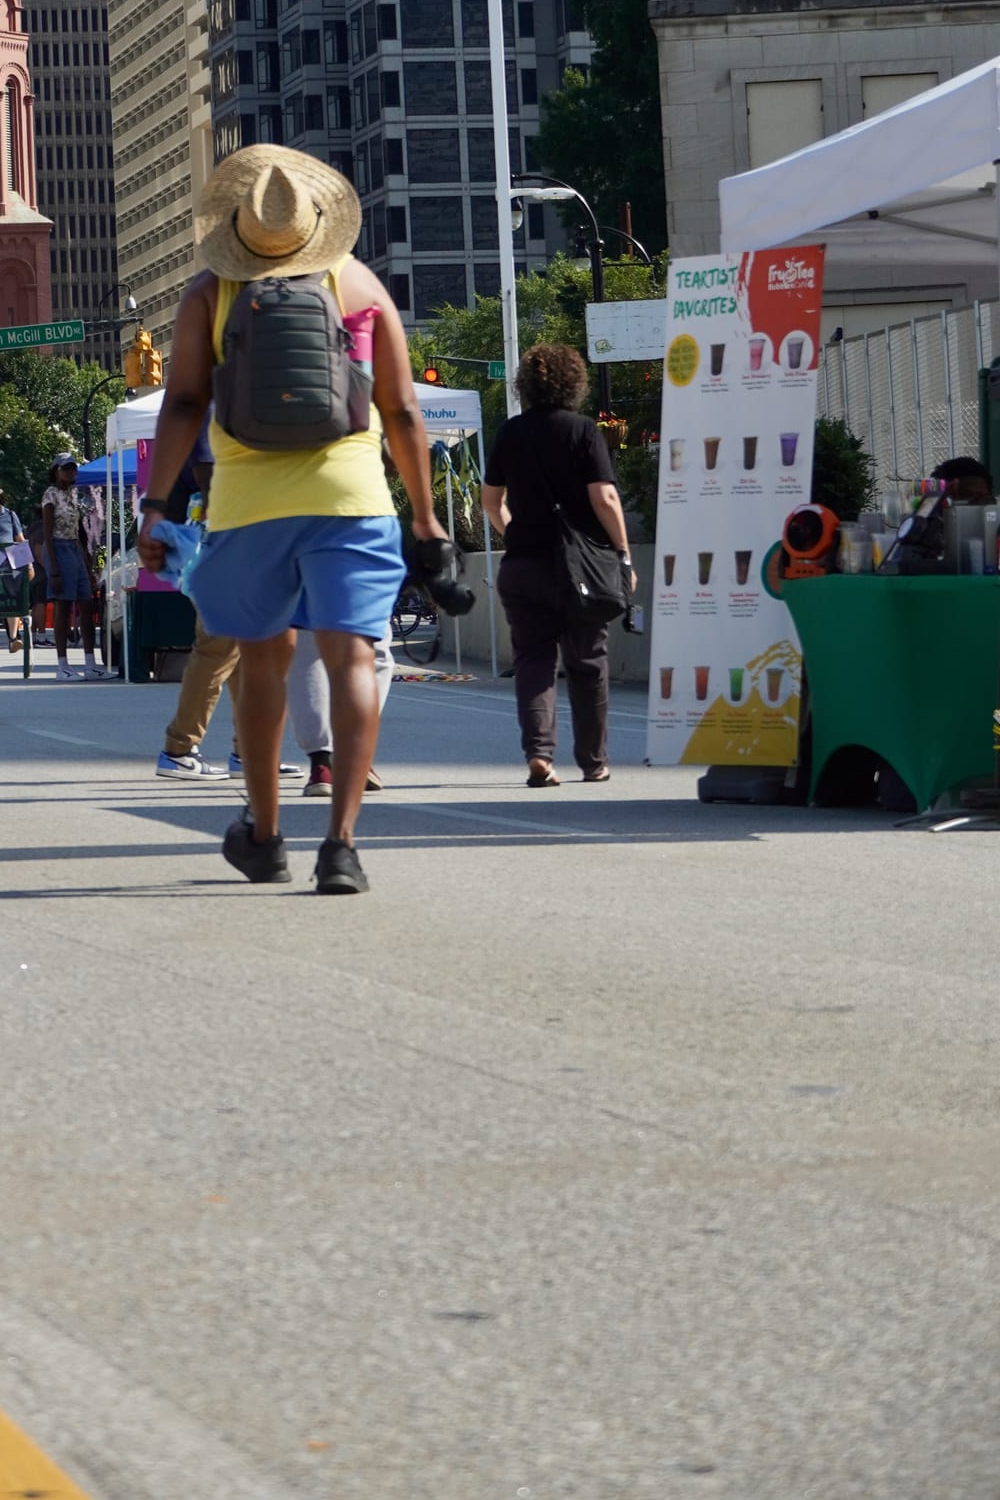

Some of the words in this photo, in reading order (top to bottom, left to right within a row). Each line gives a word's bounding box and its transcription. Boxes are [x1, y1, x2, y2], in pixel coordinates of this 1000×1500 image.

[675, 266, 739, 289] TEARTIST
[7, 329, 40, 344] McGill
[45, 325, 73, 340] BLVD
